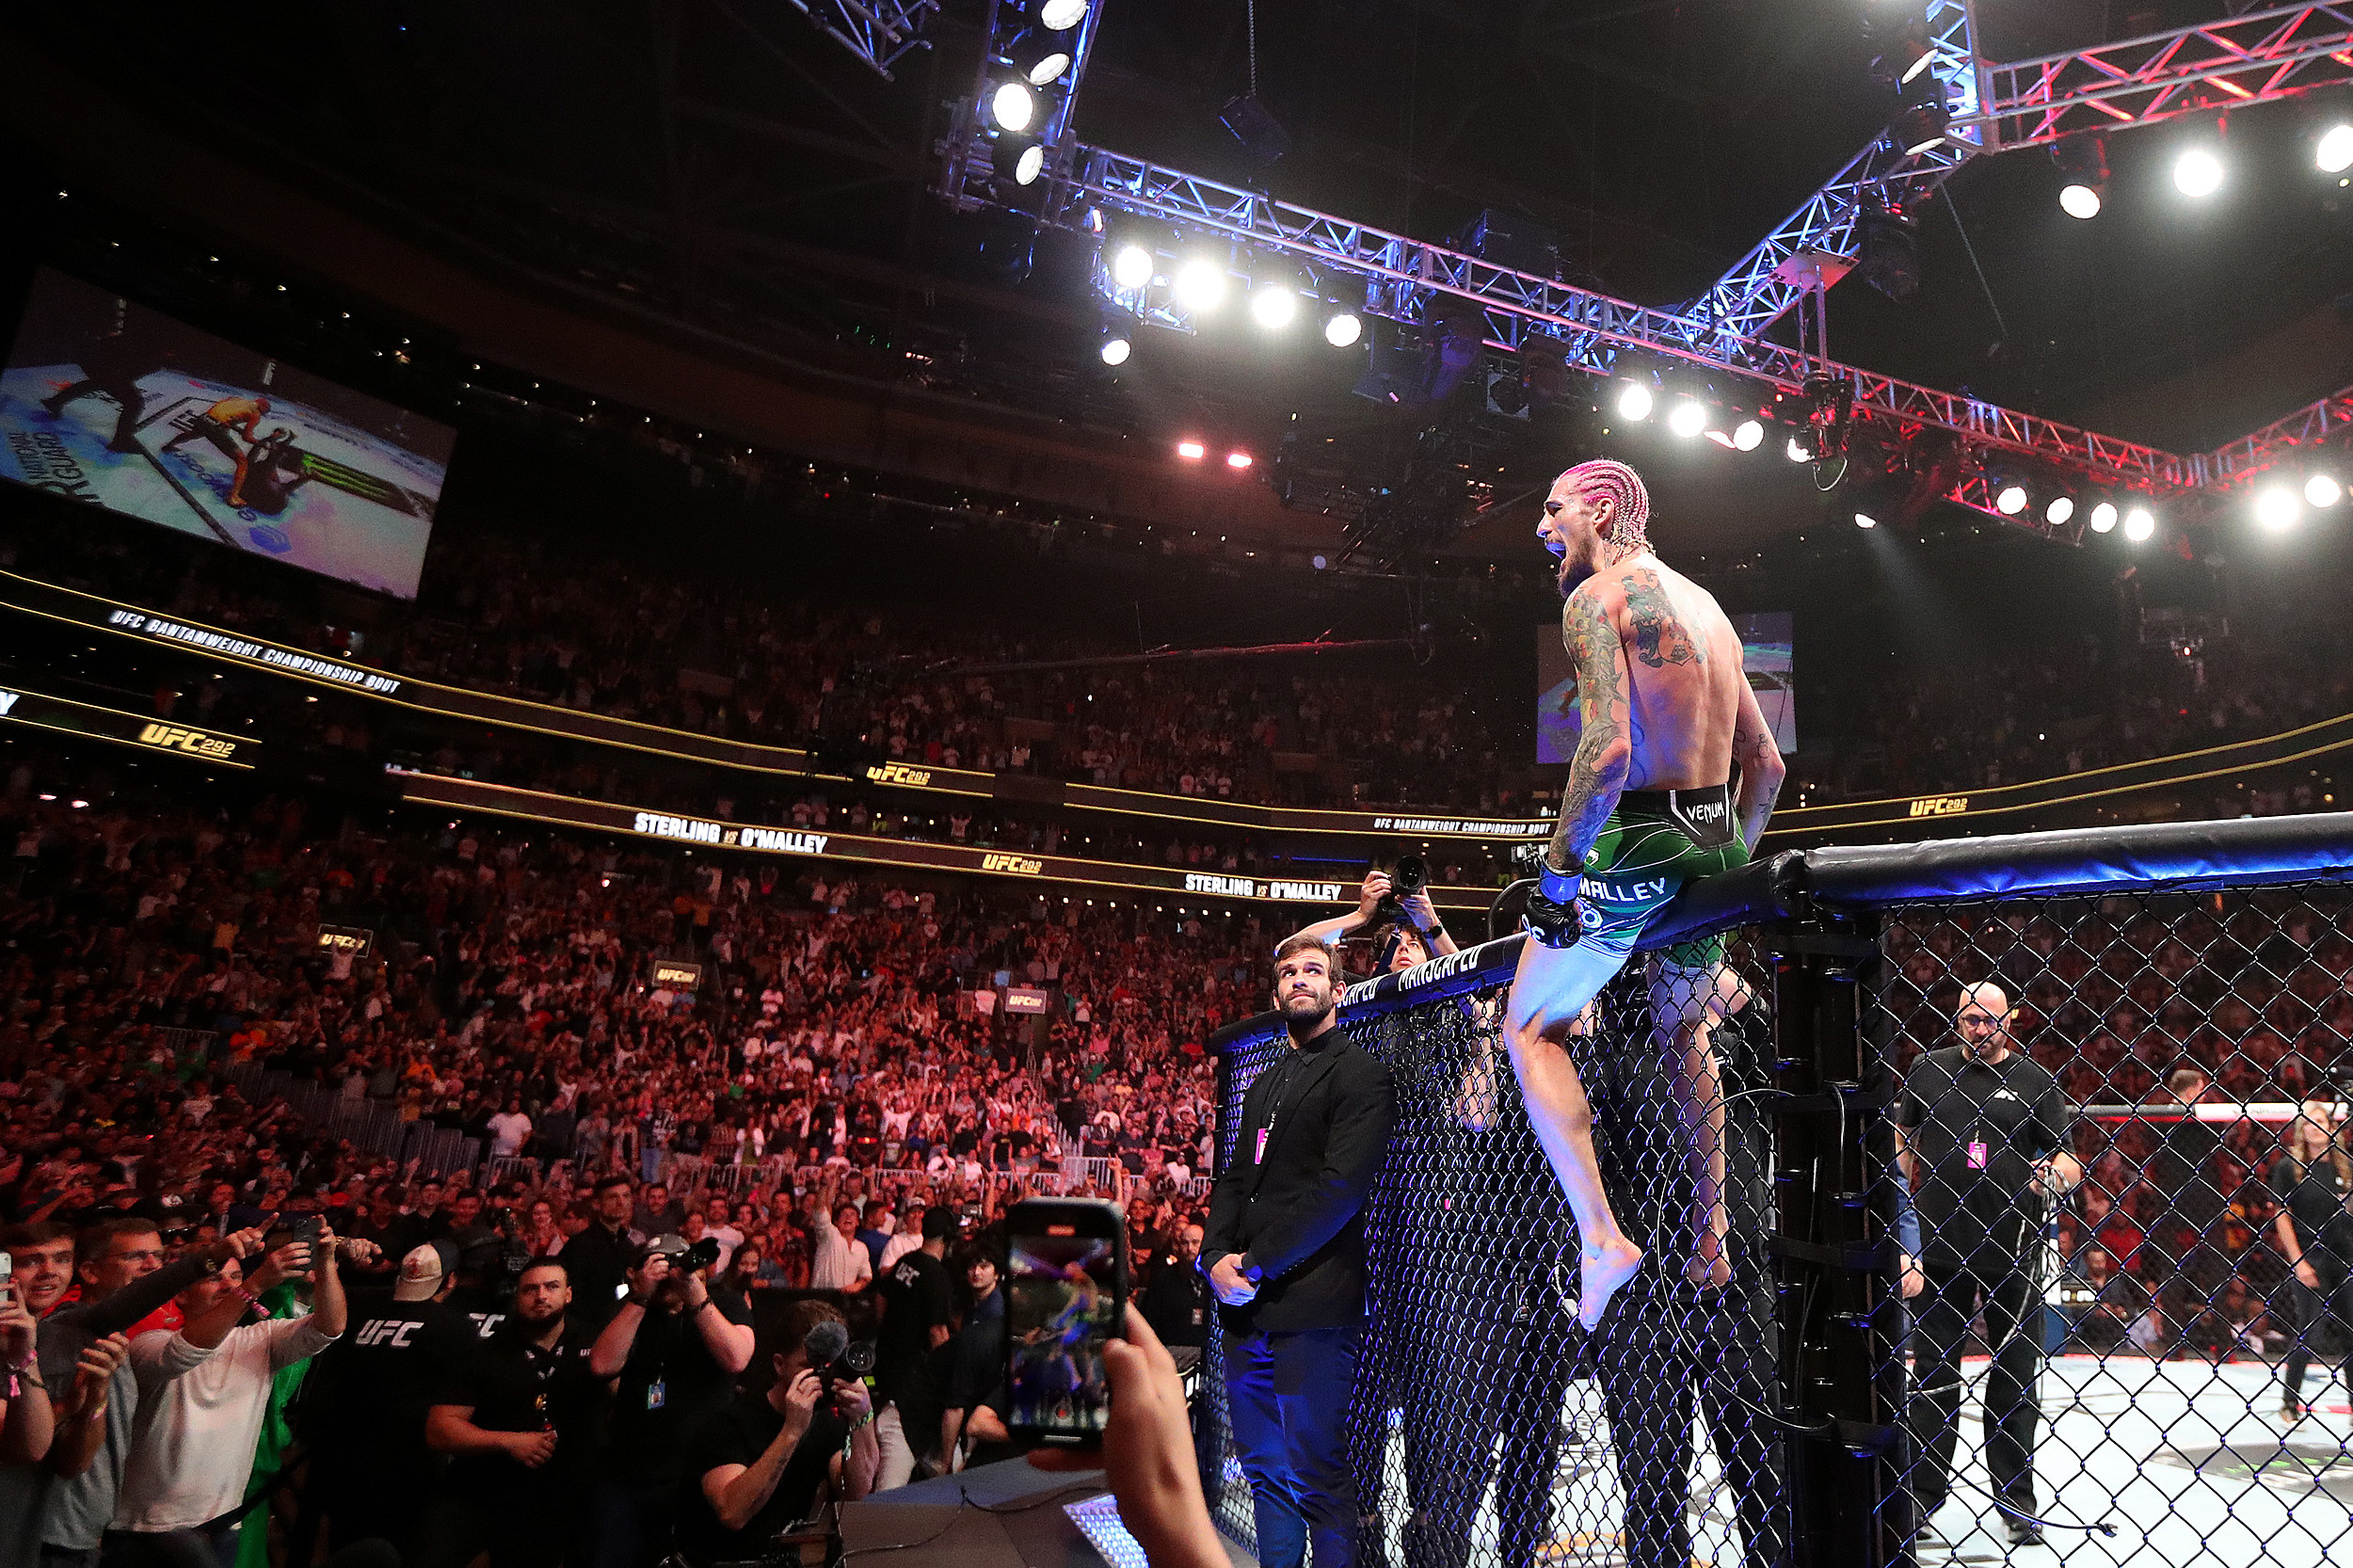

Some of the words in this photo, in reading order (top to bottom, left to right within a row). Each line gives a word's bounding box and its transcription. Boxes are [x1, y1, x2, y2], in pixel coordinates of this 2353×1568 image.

[108, 610, 146, 629] UFC
[146, 618, 264, 658] BANTAMWEIGHT
[263, 648, 365, 683] CHAMPIONSHIP
[363, 674, 401, 695] BOUT
[1373, 817, 1392, 829] UFC
[1393, 819, 1461, 832] BANTAMWEIGHT
[1462, 822, 1527, 835] CHAMPIONSHIP
[1528, 824, 1551, 835] BOUT
[1686, 801, 1725, 824] VENUM
[634, 812, 721, 843] STERLING
[740, 828, 828, 855] O'MALLEY
[1185, 873, 1255, 897] STERLING
[1270, 882, 1343, 901] O'MALLEY
[1577, 876, 1666, 902] MALLEY
[356, 1319, 425, 1348] UFC
